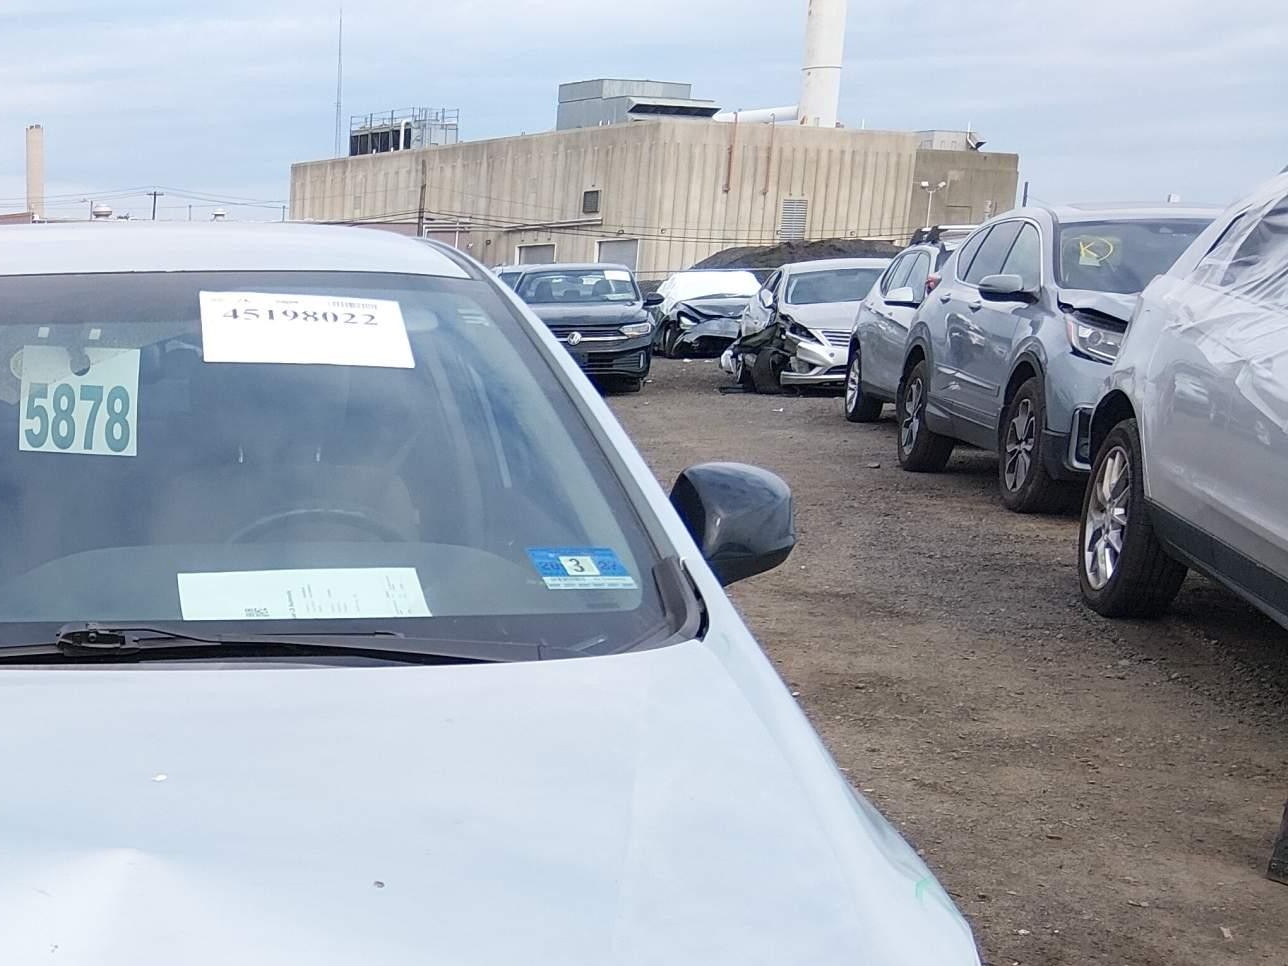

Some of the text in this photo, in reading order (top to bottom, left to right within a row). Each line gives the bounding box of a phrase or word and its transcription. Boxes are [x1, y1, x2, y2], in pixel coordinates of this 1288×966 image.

[223, 307, 378, 326] 45198022
[24, 382, 131, 453] 5878
[569, 558, 585, 573] 3
